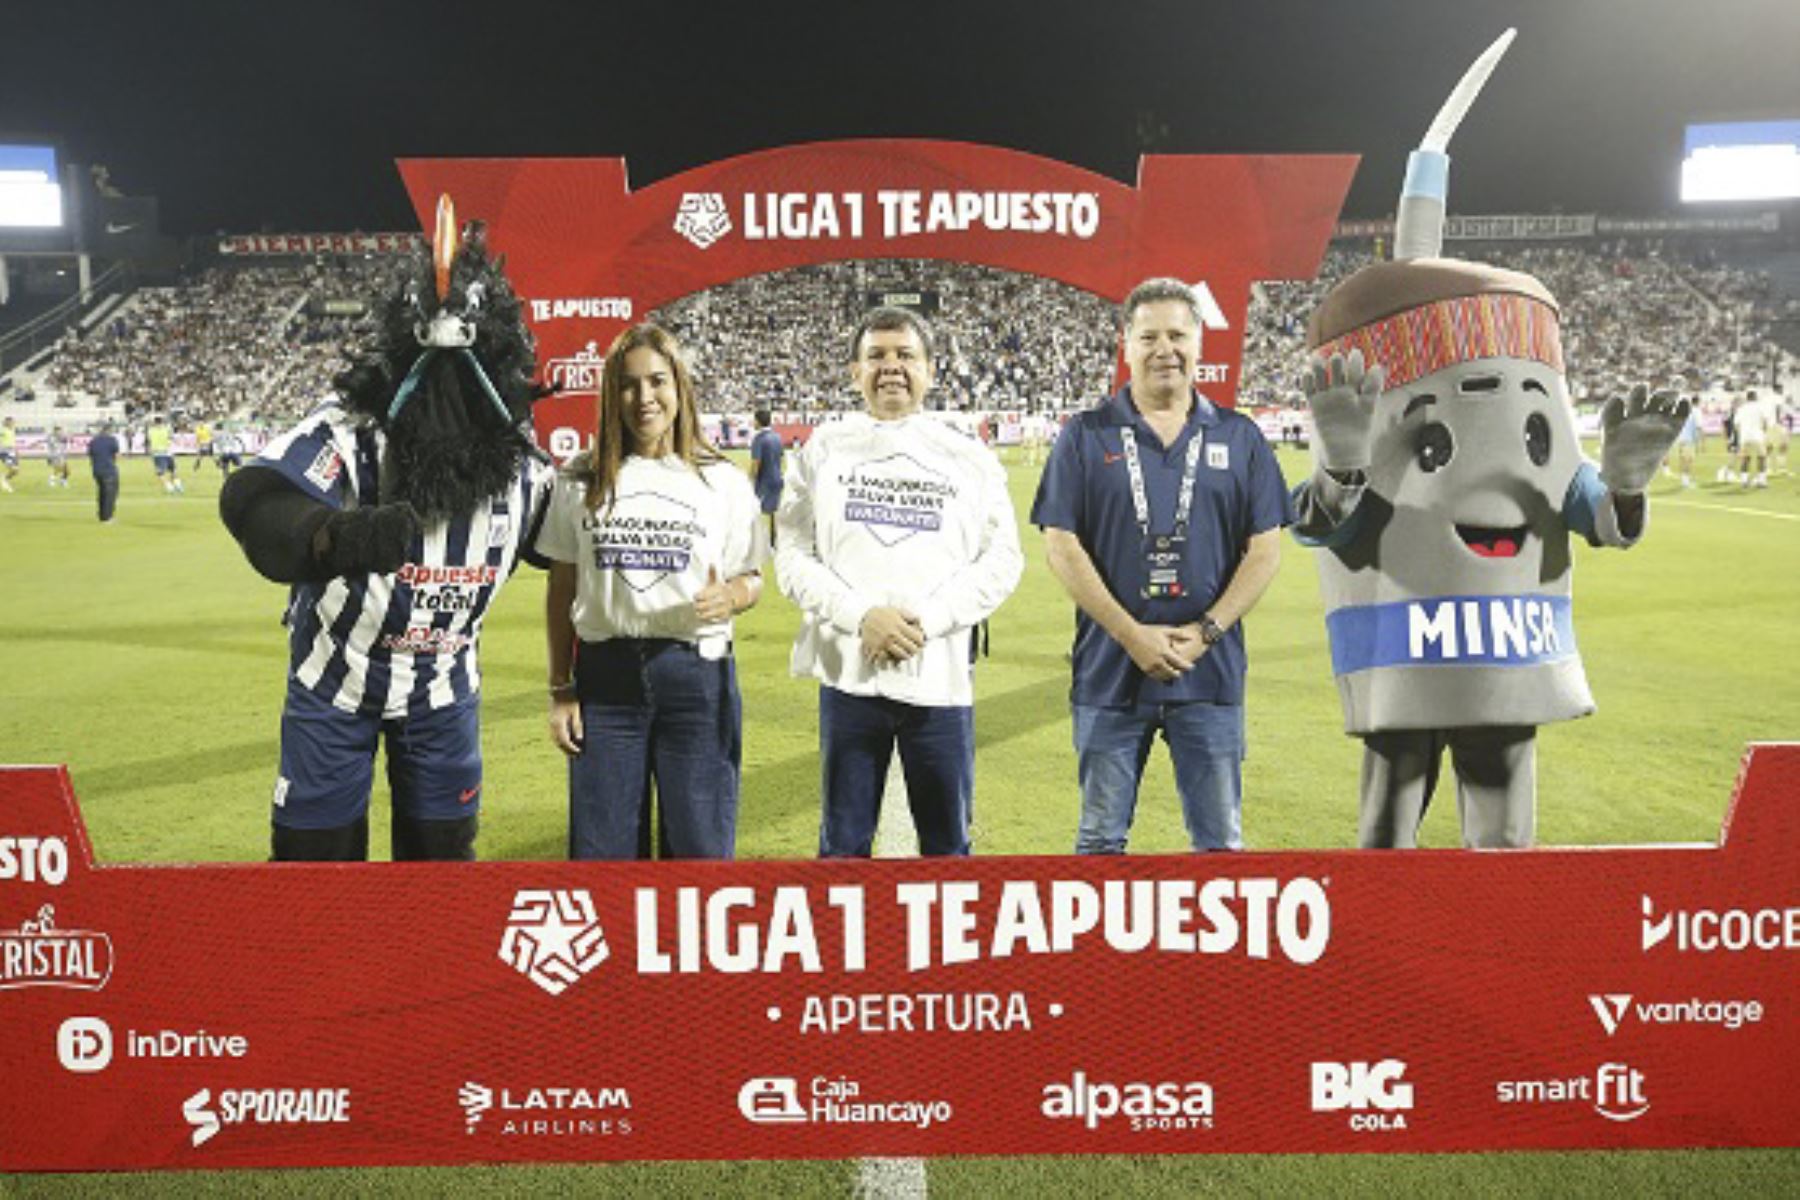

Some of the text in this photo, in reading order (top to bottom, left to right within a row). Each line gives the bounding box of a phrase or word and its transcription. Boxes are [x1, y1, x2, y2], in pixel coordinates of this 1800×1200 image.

[744, 191, 1100, 239] LIGA 1 TE APUESTO
[531, 298, 633, 322] TE APUESTO
[1409, 598, 1560, 659] MINSA
[635, 876, 1331, 973] LIGA 1 TE APUESTO
[0, 938, 101, 980] RISTAL
[799, 992, 1032, 1034] APERTURA
[1636, 998, 1763, 1029] vantage
[128, 1029, 248, 1057] inDrive
[501, 1087, 632, 1109] LATAM
[811, 1075, 860, 1100] Caja
[1041, 1071, 1213, 1129] alpasa
[1311, 1058, 1414, 1111] BIG
[1496, 1062, 1648, 1105] smart fit
[219, 1088, 350, 1123] SPORADE
[811, 1099, 952, 1129] Huancayo
[502, 1120, 632, 1135] AIRLINES
[1130, 1116, 1214, 1131] SPORTS
[1349, 1114, 1407, 1131] COLA
